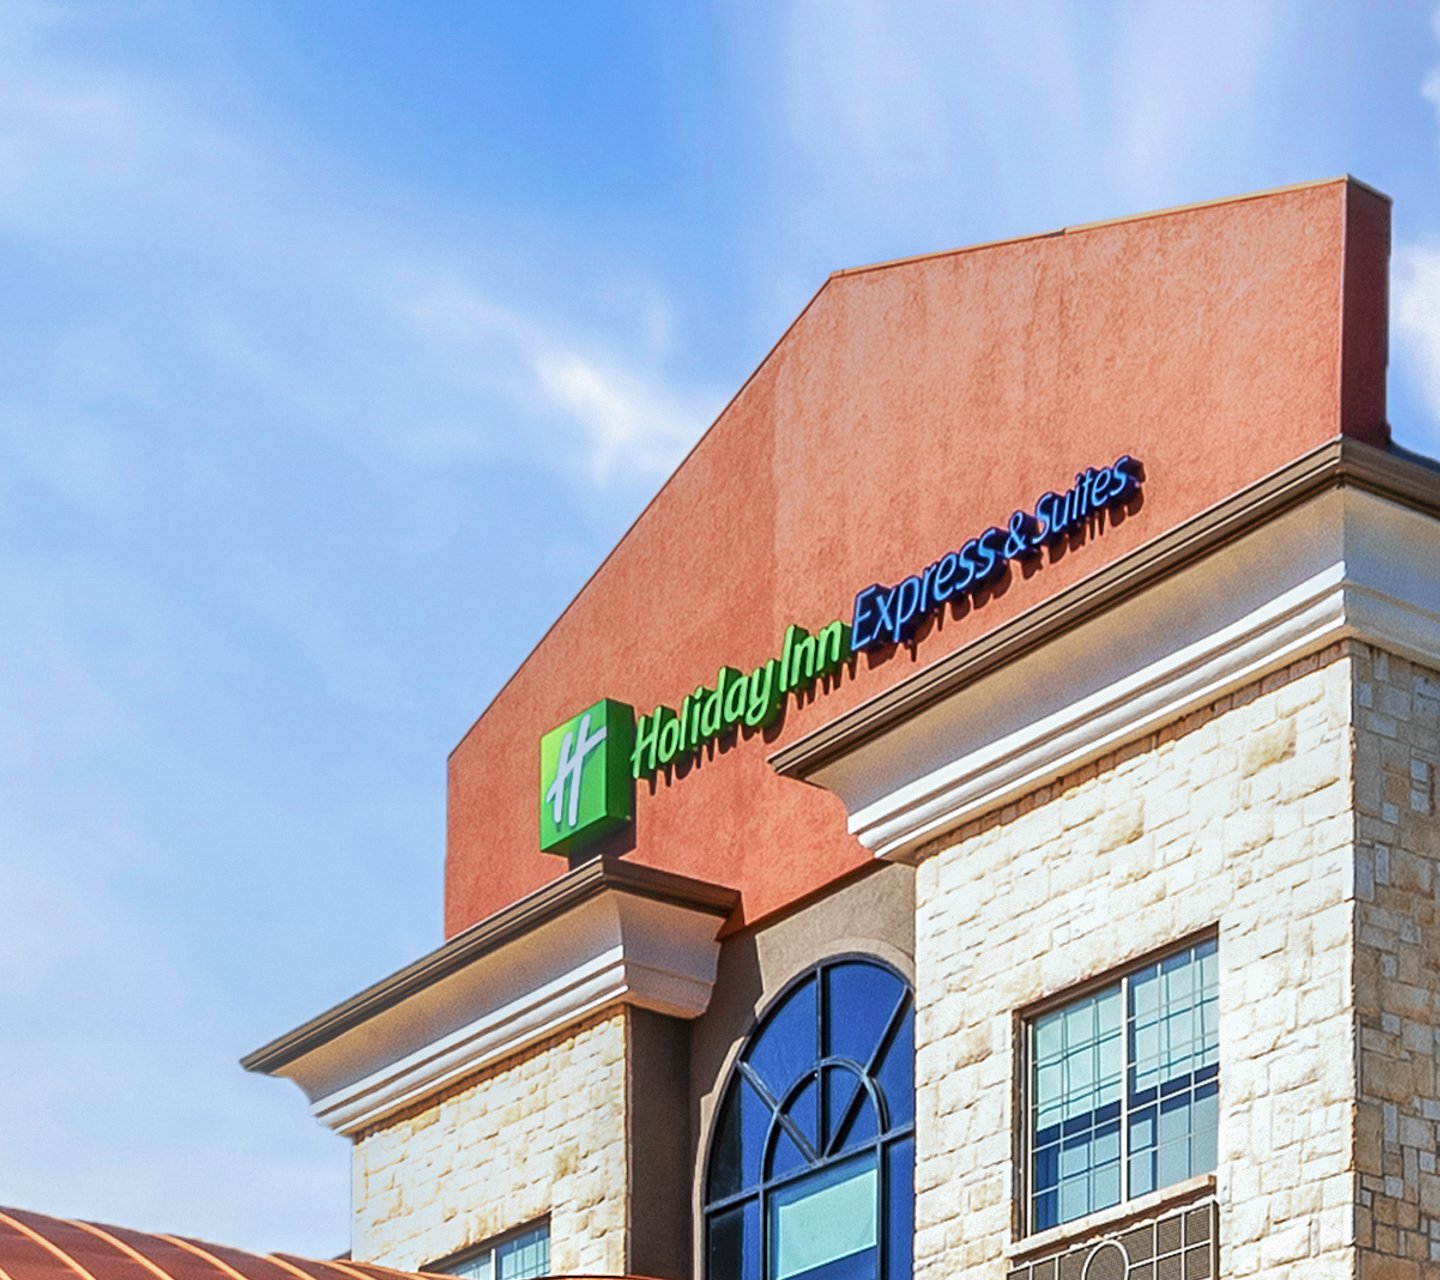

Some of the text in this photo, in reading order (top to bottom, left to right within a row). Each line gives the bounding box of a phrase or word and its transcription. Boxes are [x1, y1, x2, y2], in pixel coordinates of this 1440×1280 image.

[630, 456, 1131, 779] Holiday Inn Express & Suites
